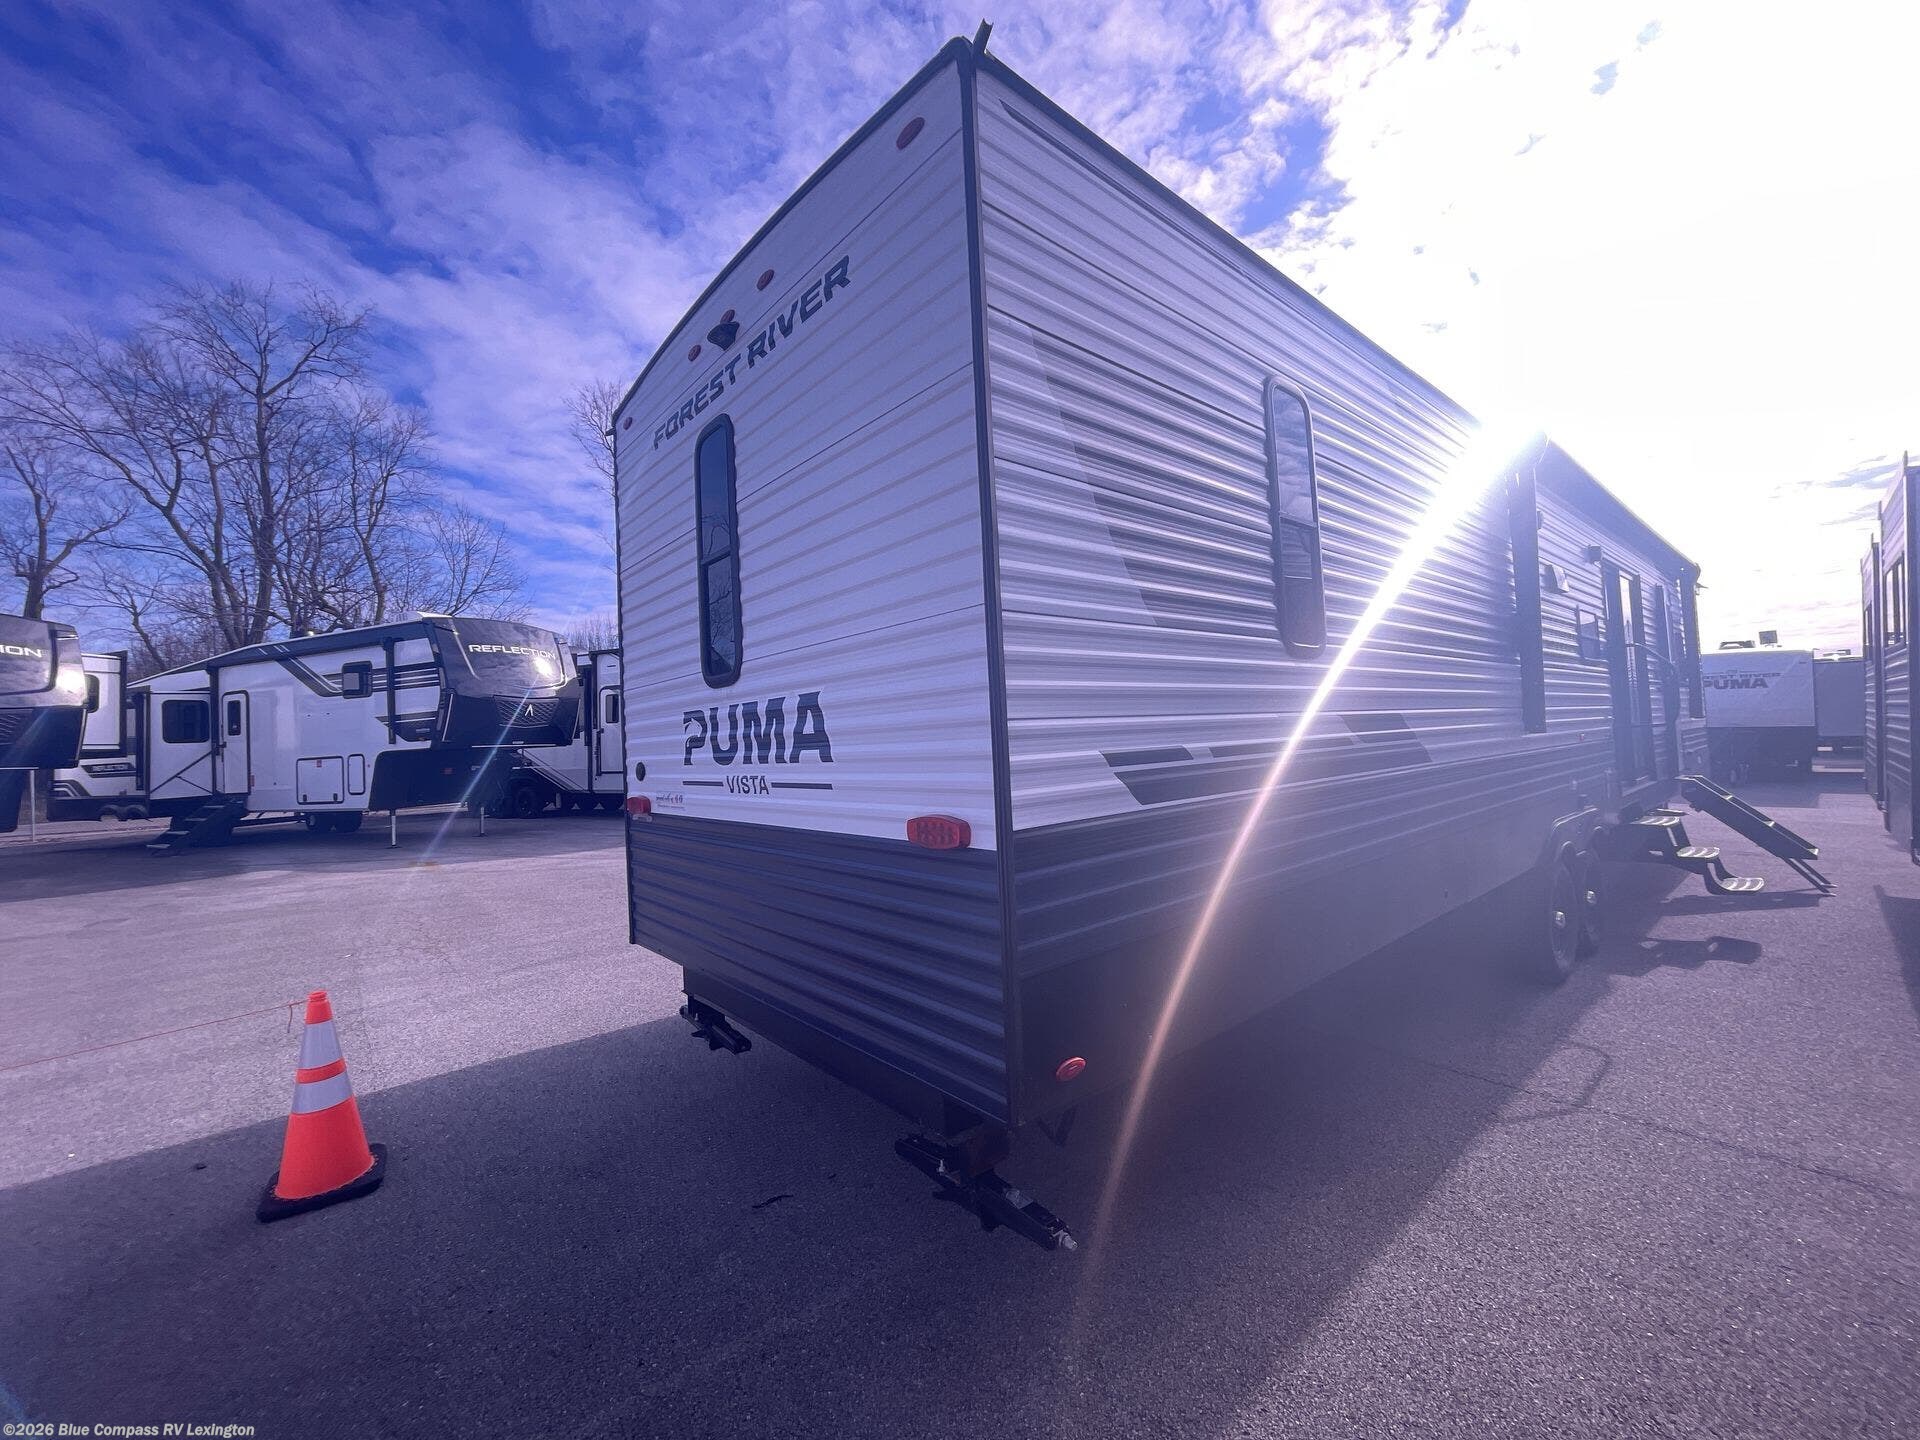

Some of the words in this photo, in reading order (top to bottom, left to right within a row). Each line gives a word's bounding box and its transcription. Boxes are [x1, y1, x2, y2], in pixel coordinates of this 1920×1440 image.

[653, 353, 742, 450] FOREST
[747, 254, 851, 369] RIVER
[468, 644, 556, 660] REFLECTION
[1703, 678, 1769, 690] PUMA
[682, 690, 834, 766] PUMA
[726, 775, 770, 795] VISTA
